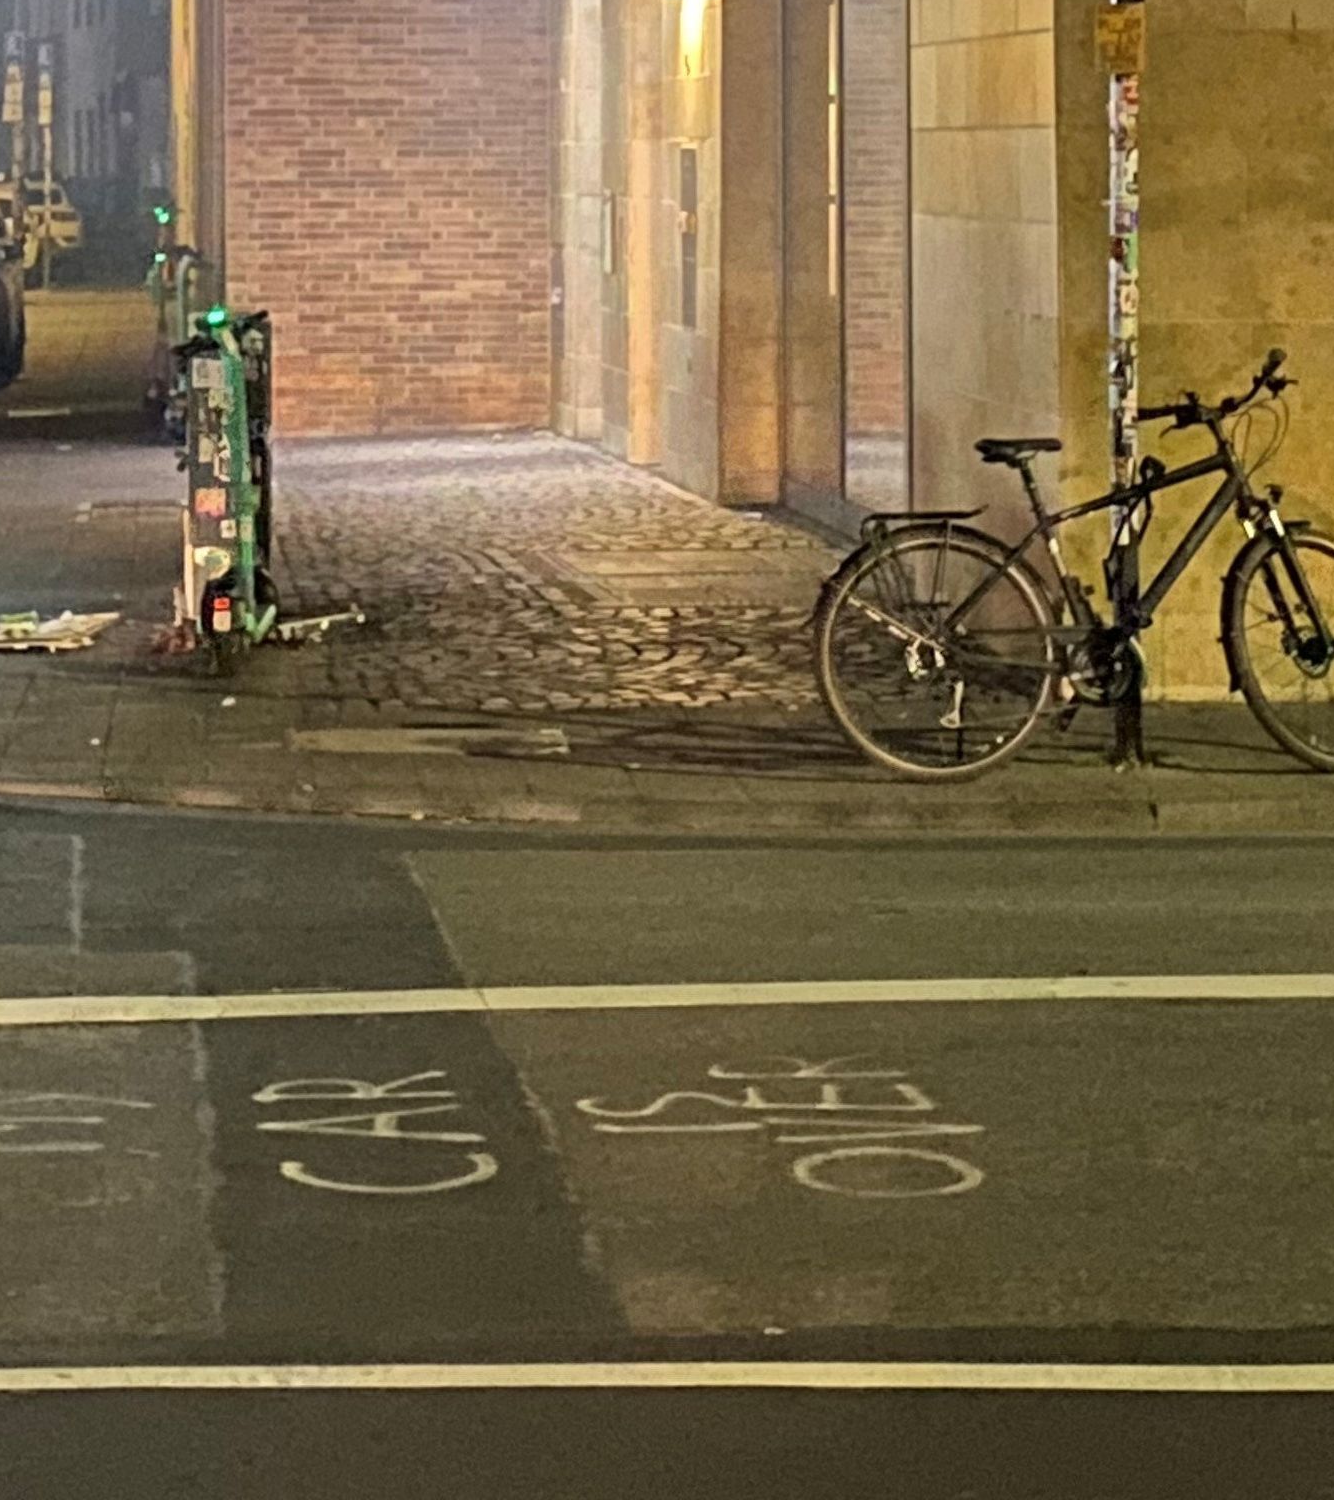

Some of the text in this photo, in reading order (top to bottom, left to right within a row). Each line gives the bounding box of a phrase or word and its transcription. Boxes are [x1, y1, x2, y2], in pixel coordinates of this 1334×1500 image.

[249, 1072, 499, 1193] CAR
[575, 1092, 763, 1132] IS
[706, 1054, 985, 1197] OVER
